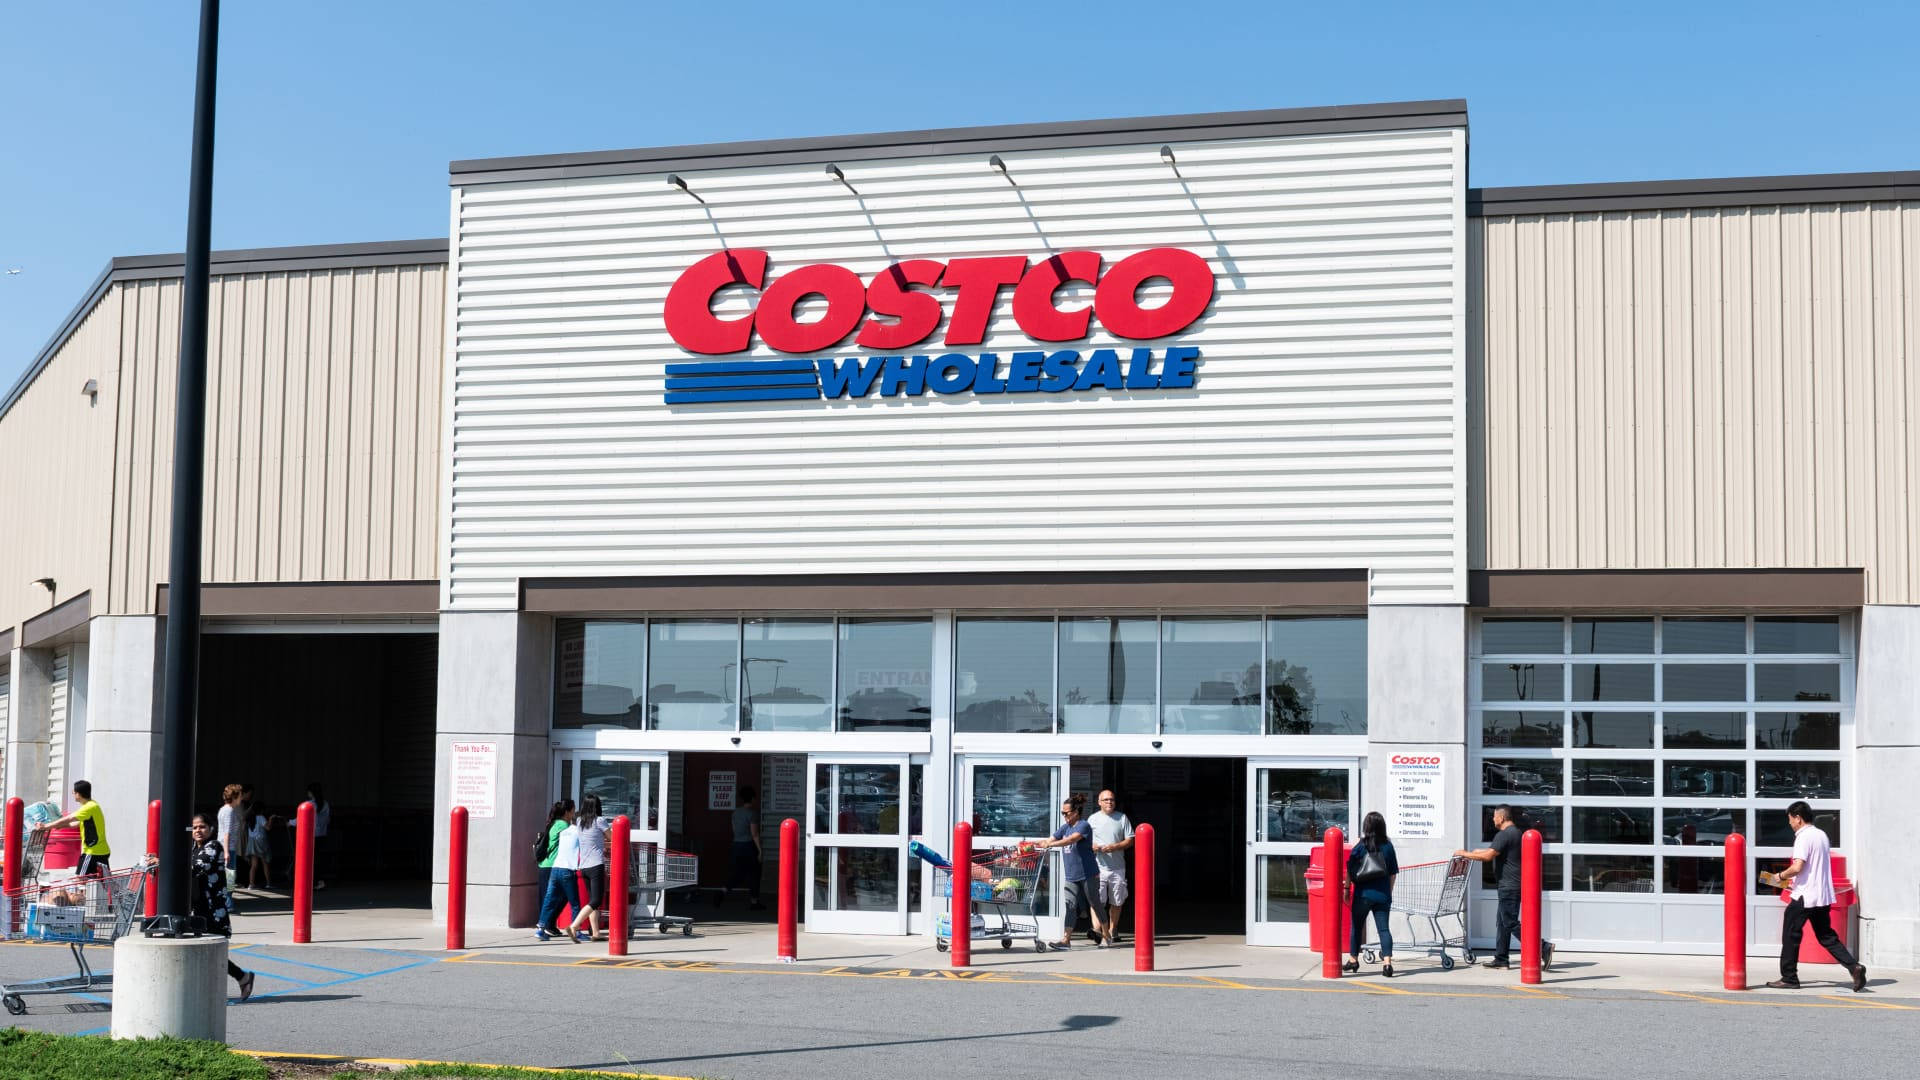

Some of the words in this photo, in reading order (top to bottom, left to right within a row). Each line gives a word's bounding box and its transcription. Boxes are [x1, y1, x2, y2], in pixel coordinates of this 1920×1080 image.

[663, 247, 1215, 355] COSTCO
[817, 347, 1201, 399] WHOLESALE
[454, 744, 469, 752] Thank
[471, 744, 480, 752] You
[1391, 755, 1440, 764] COSTCO
[822, 965, 1018, 980] LANE
